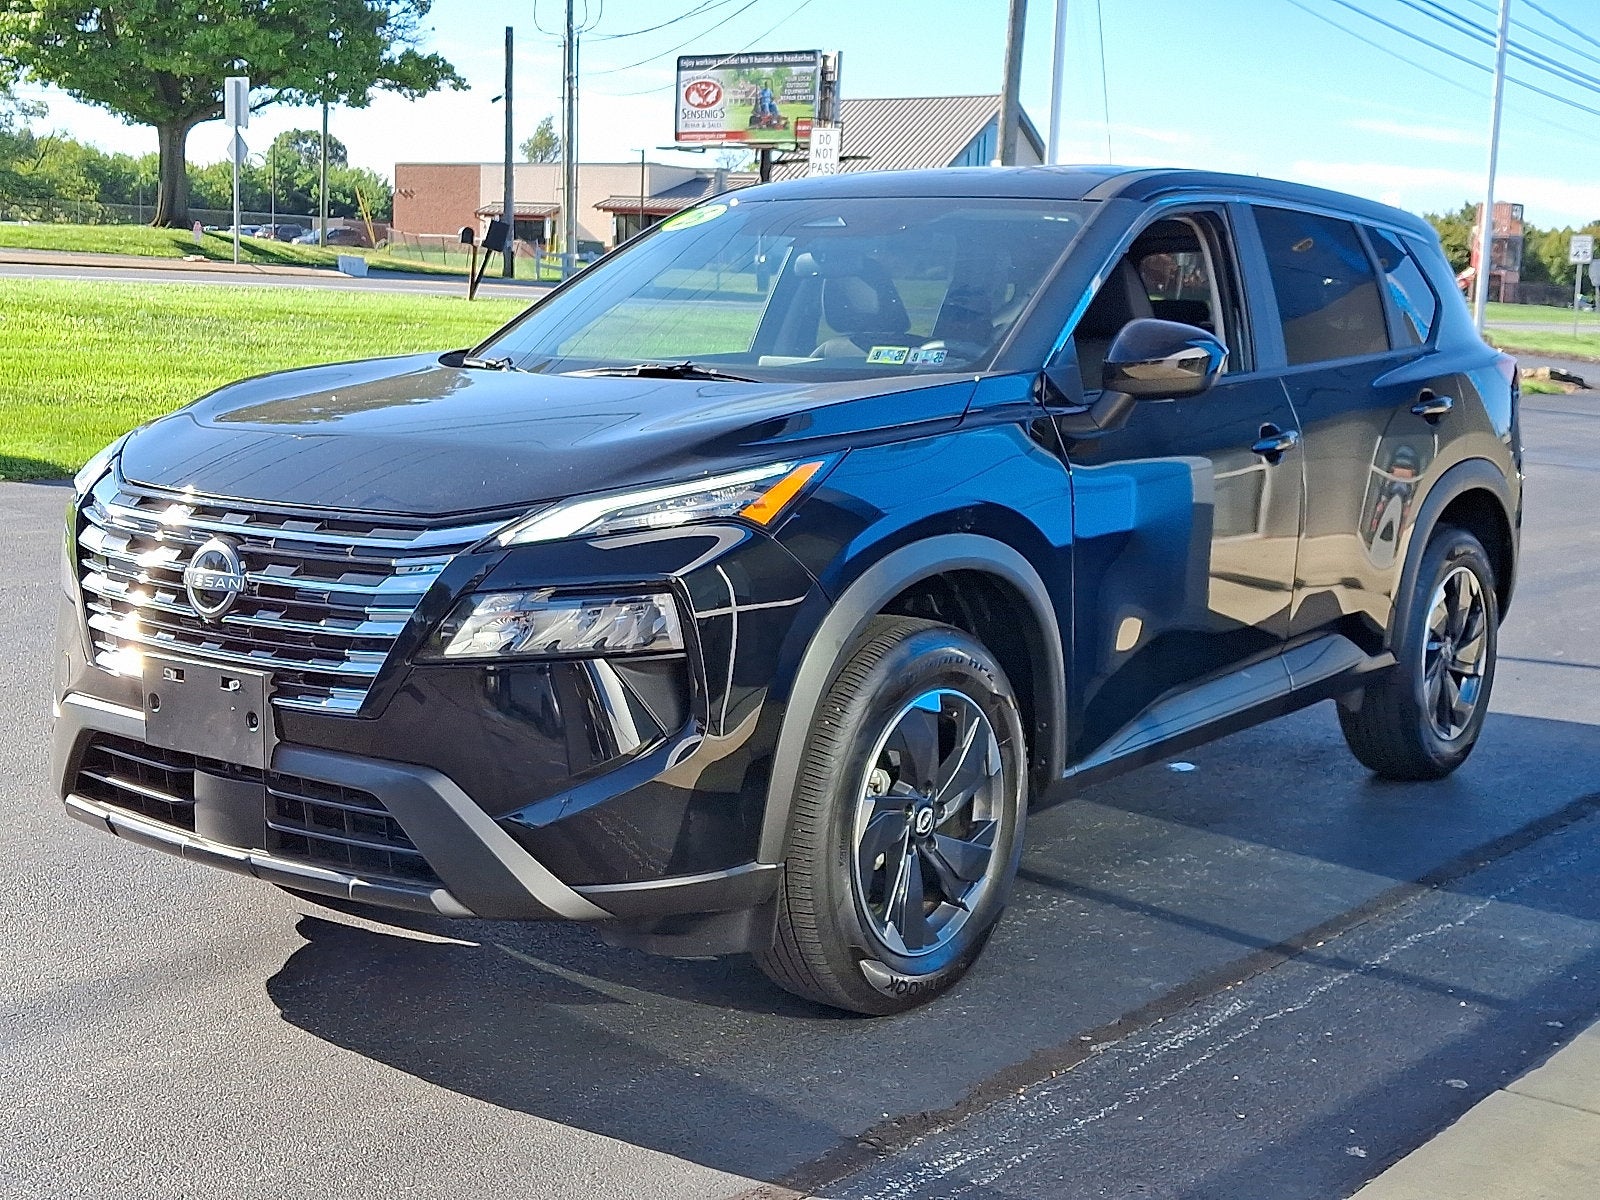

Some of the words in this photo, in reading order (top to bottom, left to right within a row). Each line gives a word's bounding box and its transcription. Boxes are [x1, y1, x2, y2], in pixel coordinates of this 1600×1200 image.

[820, 134, 832, 144] DO
[816, 148, 832, 159] NOT
[812, 163, 835, 174] PASS
[185, 571, 241, 590] NISSAN
